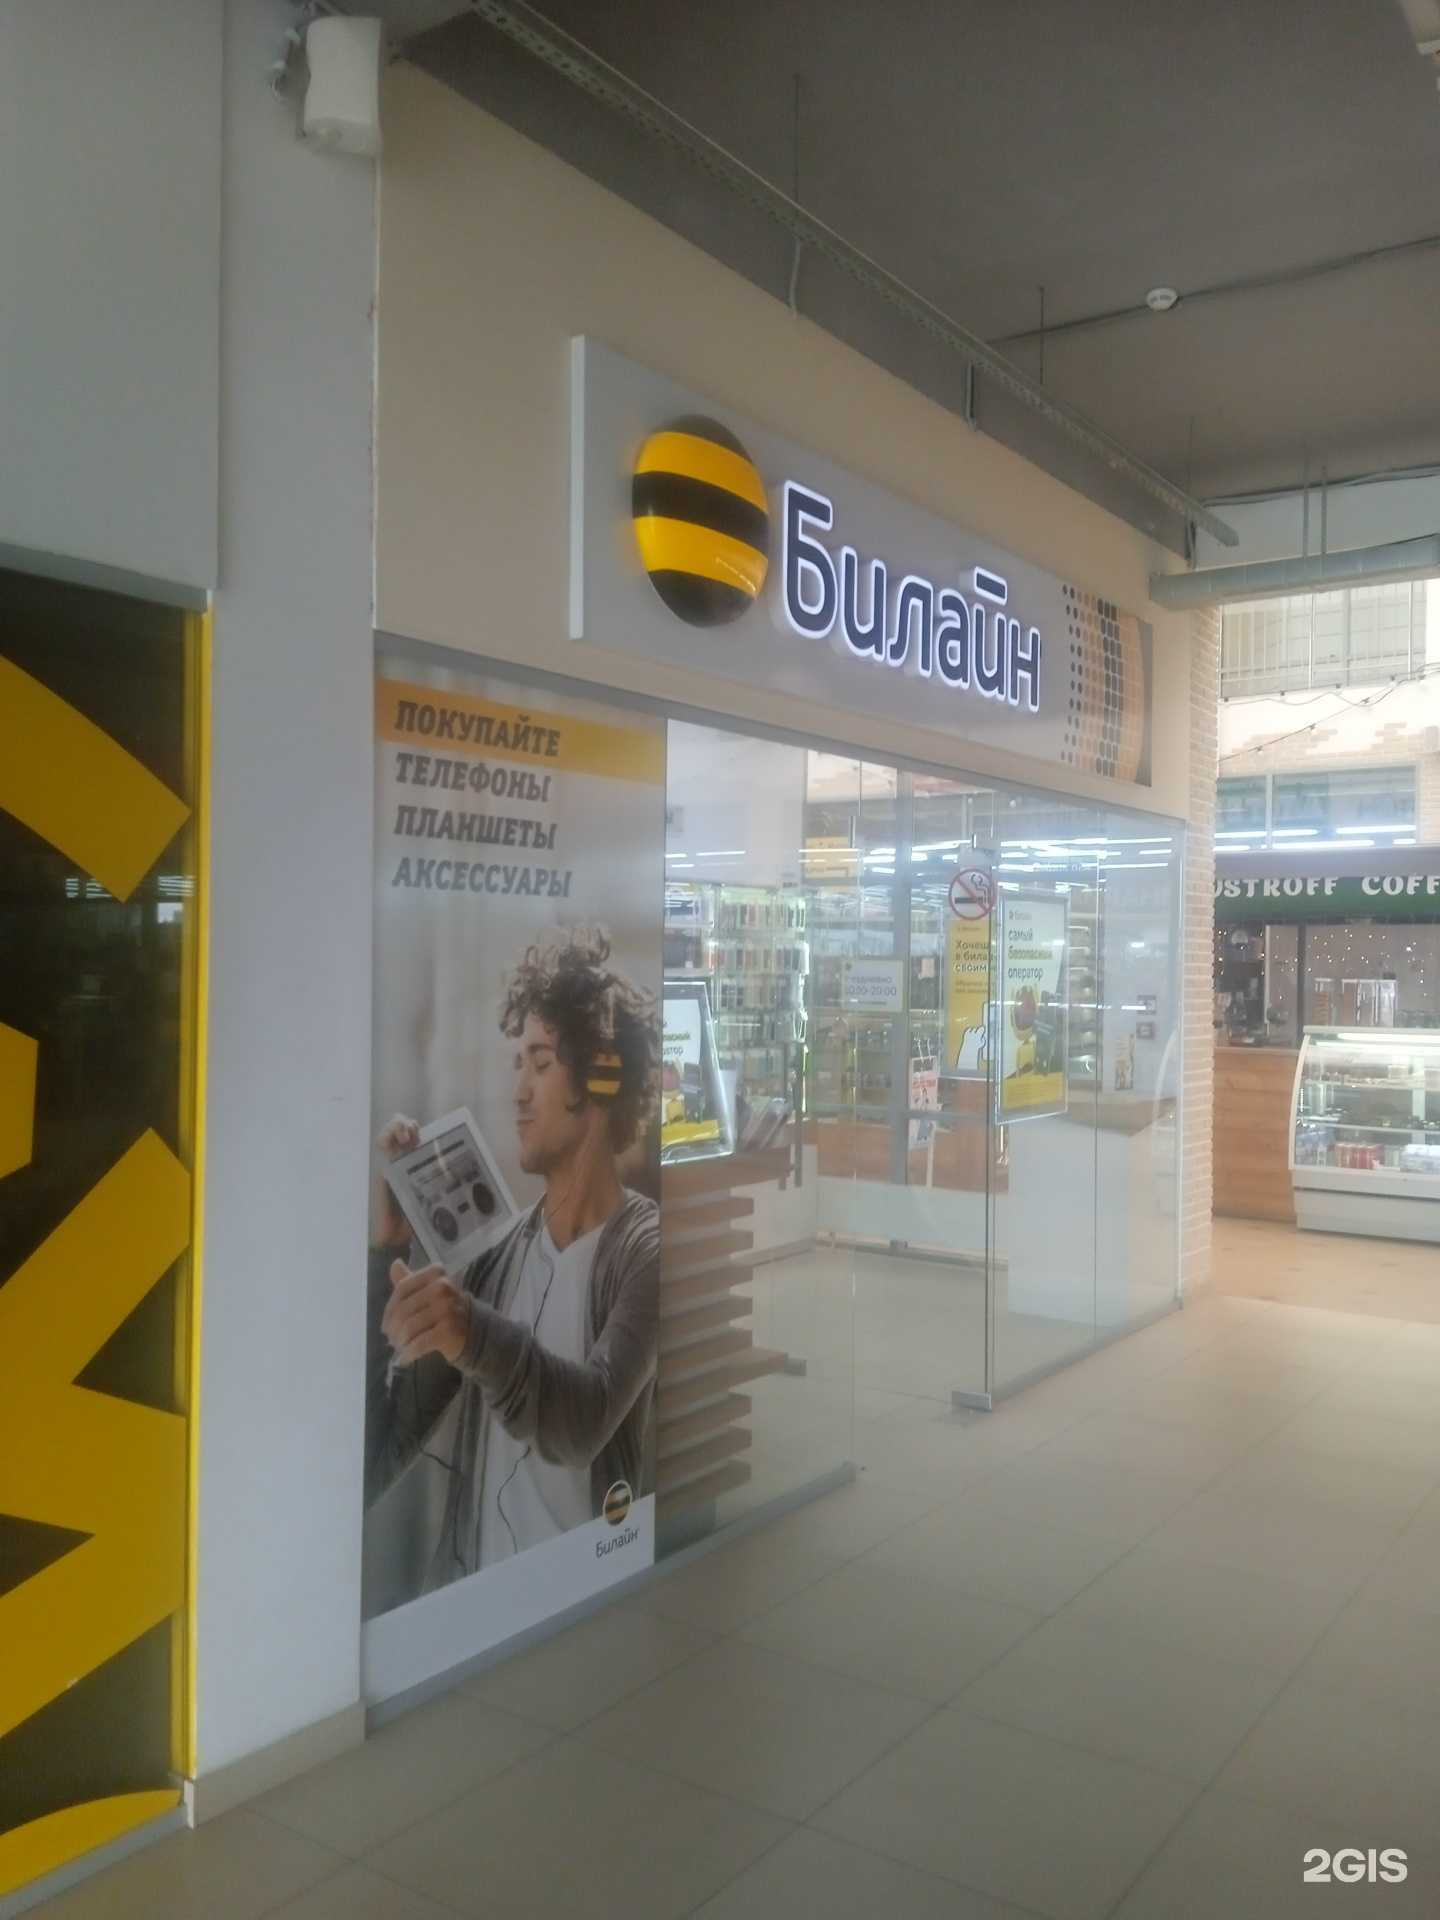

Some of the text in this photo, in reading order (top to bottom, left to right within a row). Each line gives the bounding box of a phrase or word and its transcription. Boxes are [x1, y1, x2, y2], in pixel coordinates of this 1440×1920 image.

[783, 480, 1041, 712] Билайн
[393, 700, 560, 757] ПОКУПАЙТЕ
[396, 752, 552, 802] ТЕЛЕФОНЫ
[394, 805, 558, 850] ПЛАНШЕТЫ
[392, 857, 573, 898] АКСЕССУАРЫ
[1215, 877, 1339, 897] STROFF
[595, 1527, 640, 1559] Билайн
